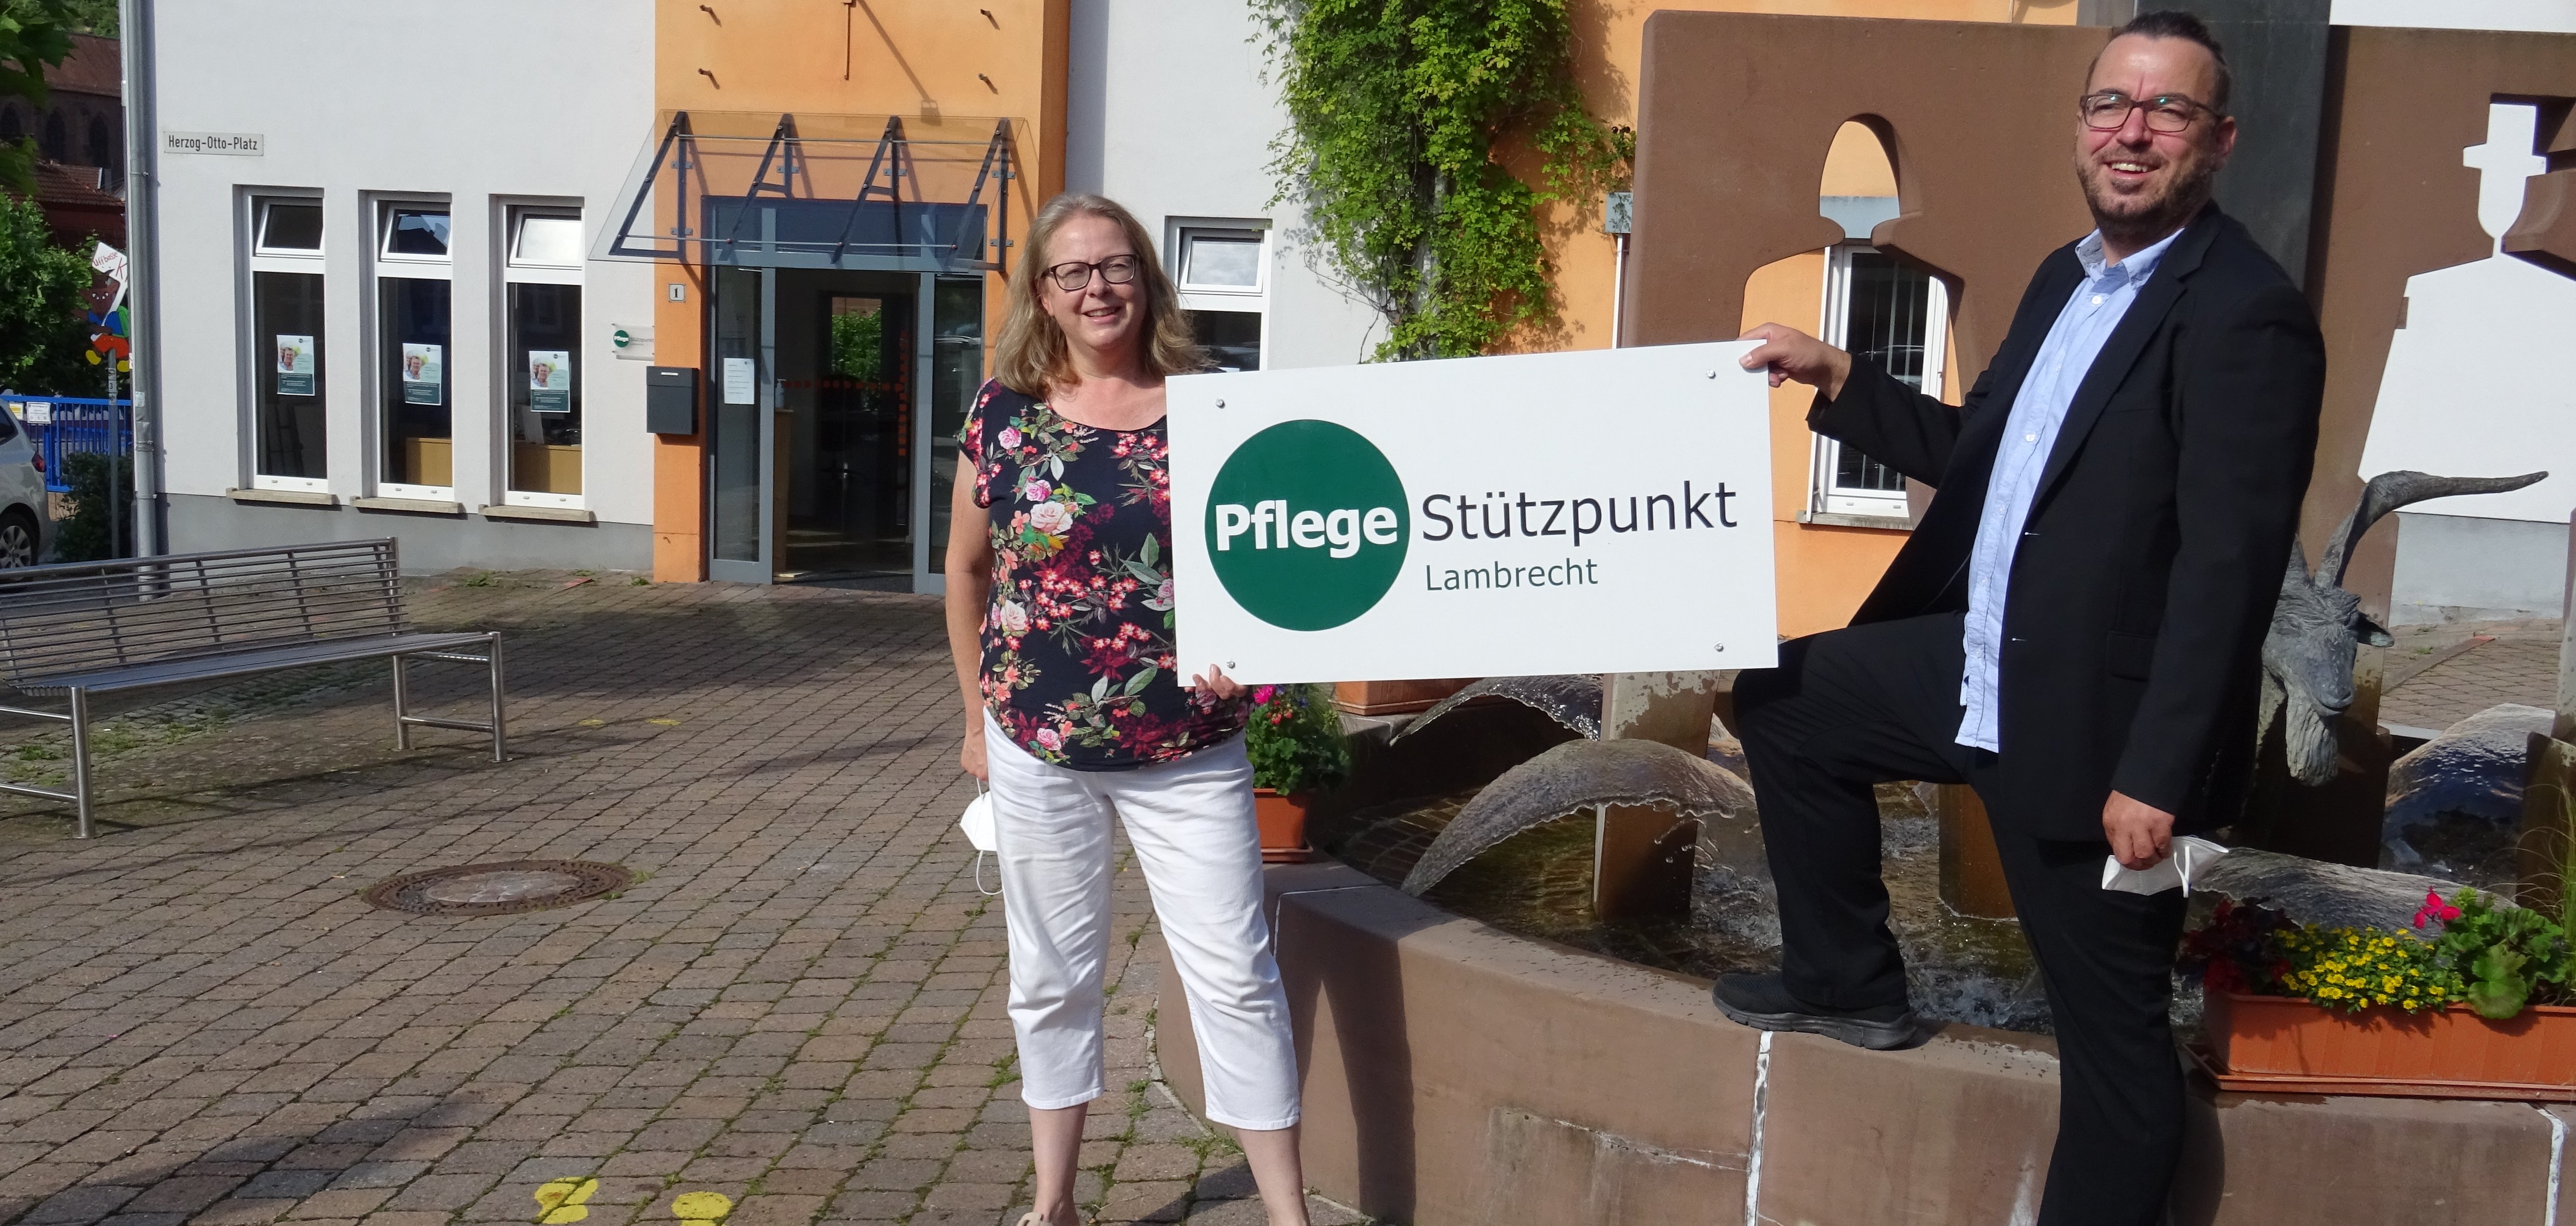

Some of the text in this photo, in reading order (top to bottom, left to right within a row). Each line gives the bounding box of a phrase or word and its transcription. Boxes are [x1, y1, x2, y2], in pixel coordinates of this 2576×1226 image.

[168, 135, 257, 152] Herzog-Otto-Platz
[674, 288, 678, 298] 1
[1216, 480, 1737, 558] Pflege Stützpunkt
[1426, 557, 1599, 591] Lambrecht
